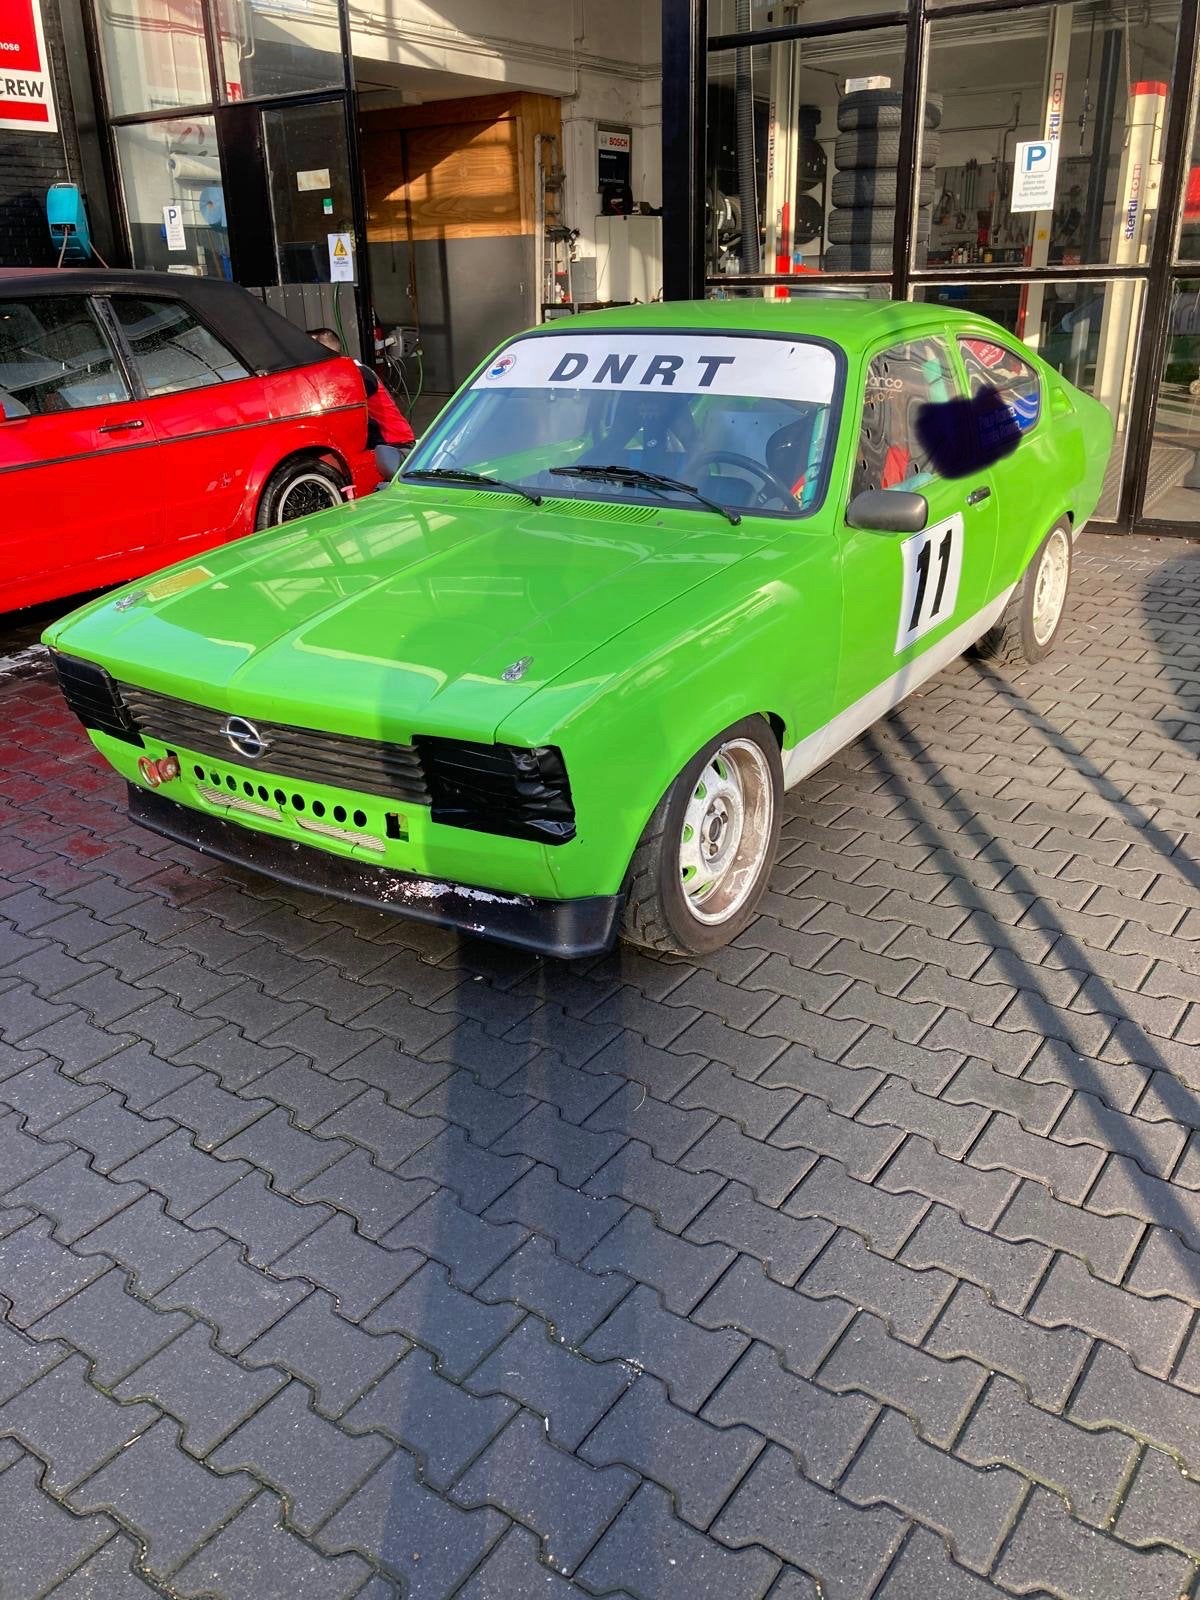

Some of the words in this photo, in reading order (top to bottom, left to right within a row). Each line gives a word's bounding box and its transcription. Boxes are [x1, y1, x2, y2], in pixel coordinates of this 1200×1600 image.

[608, 136, 628, 148] BOSCH
[1026, 145, 1047, 171] P
[168, 209, 177, 224] P
[1125, 199, 1139, 240] stertil
[548, 352, 736, 387] DNRT
[869, 376, 904, 389] arco
[907, 528, 953, 632] 11
